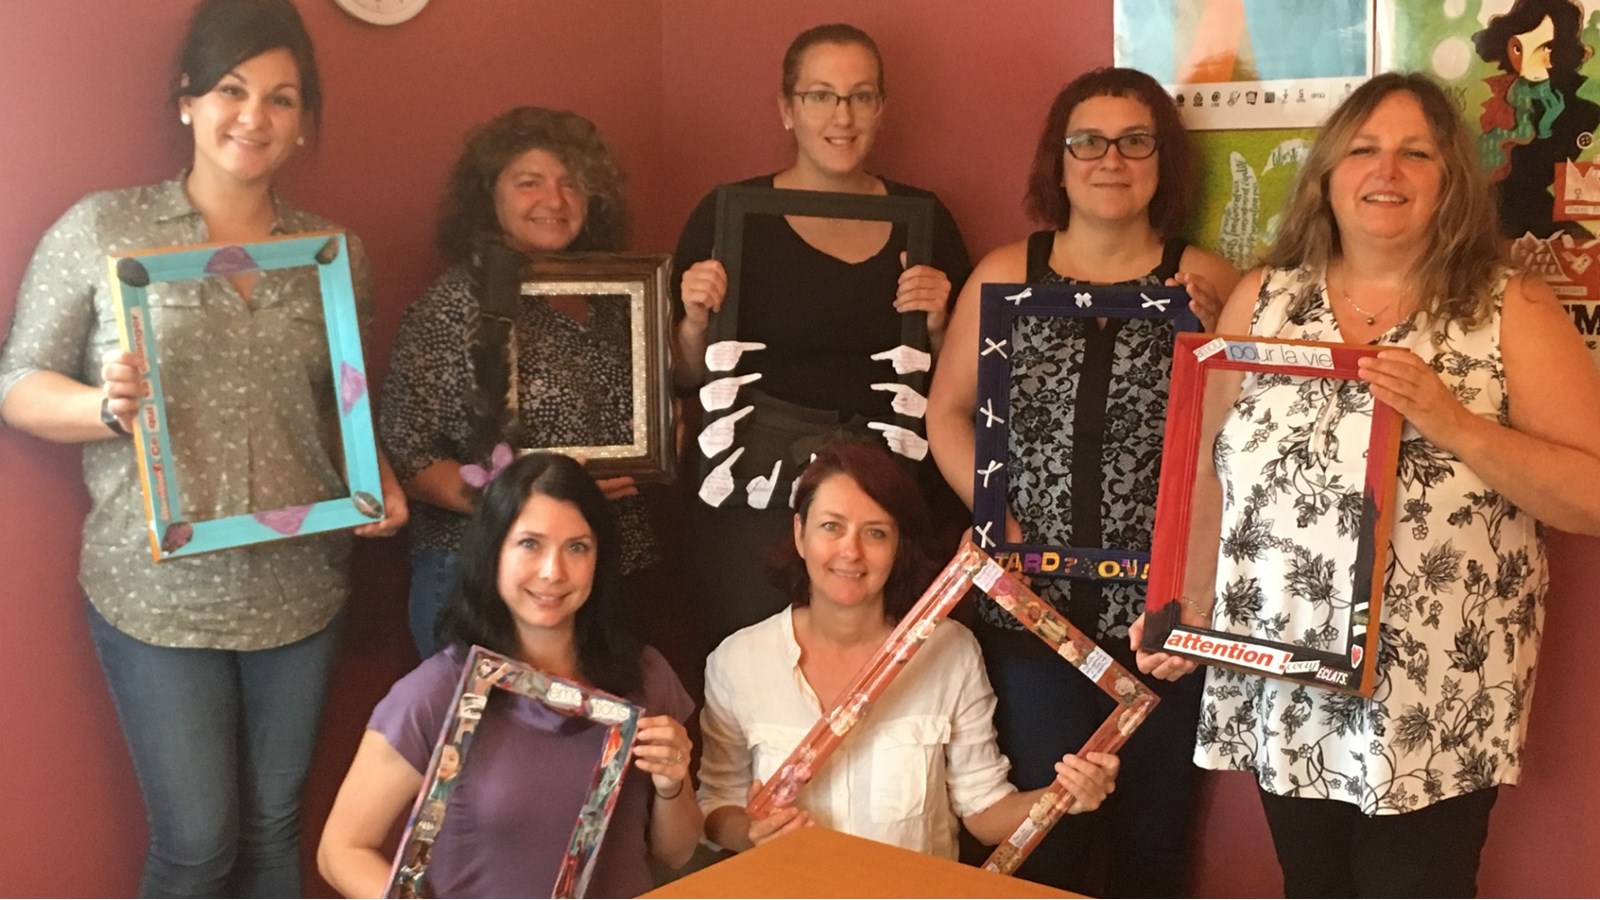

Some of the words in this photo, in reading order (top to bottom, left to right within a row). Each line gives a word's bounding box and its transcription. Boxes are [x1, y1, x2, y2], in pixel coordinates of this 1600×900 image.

[1230, 344, 1275, 361] pour
[1281, 346, 1299, 364] la
[1305, 347, 1333, 368] vie
[1167, 632, 1273, 668] attention
